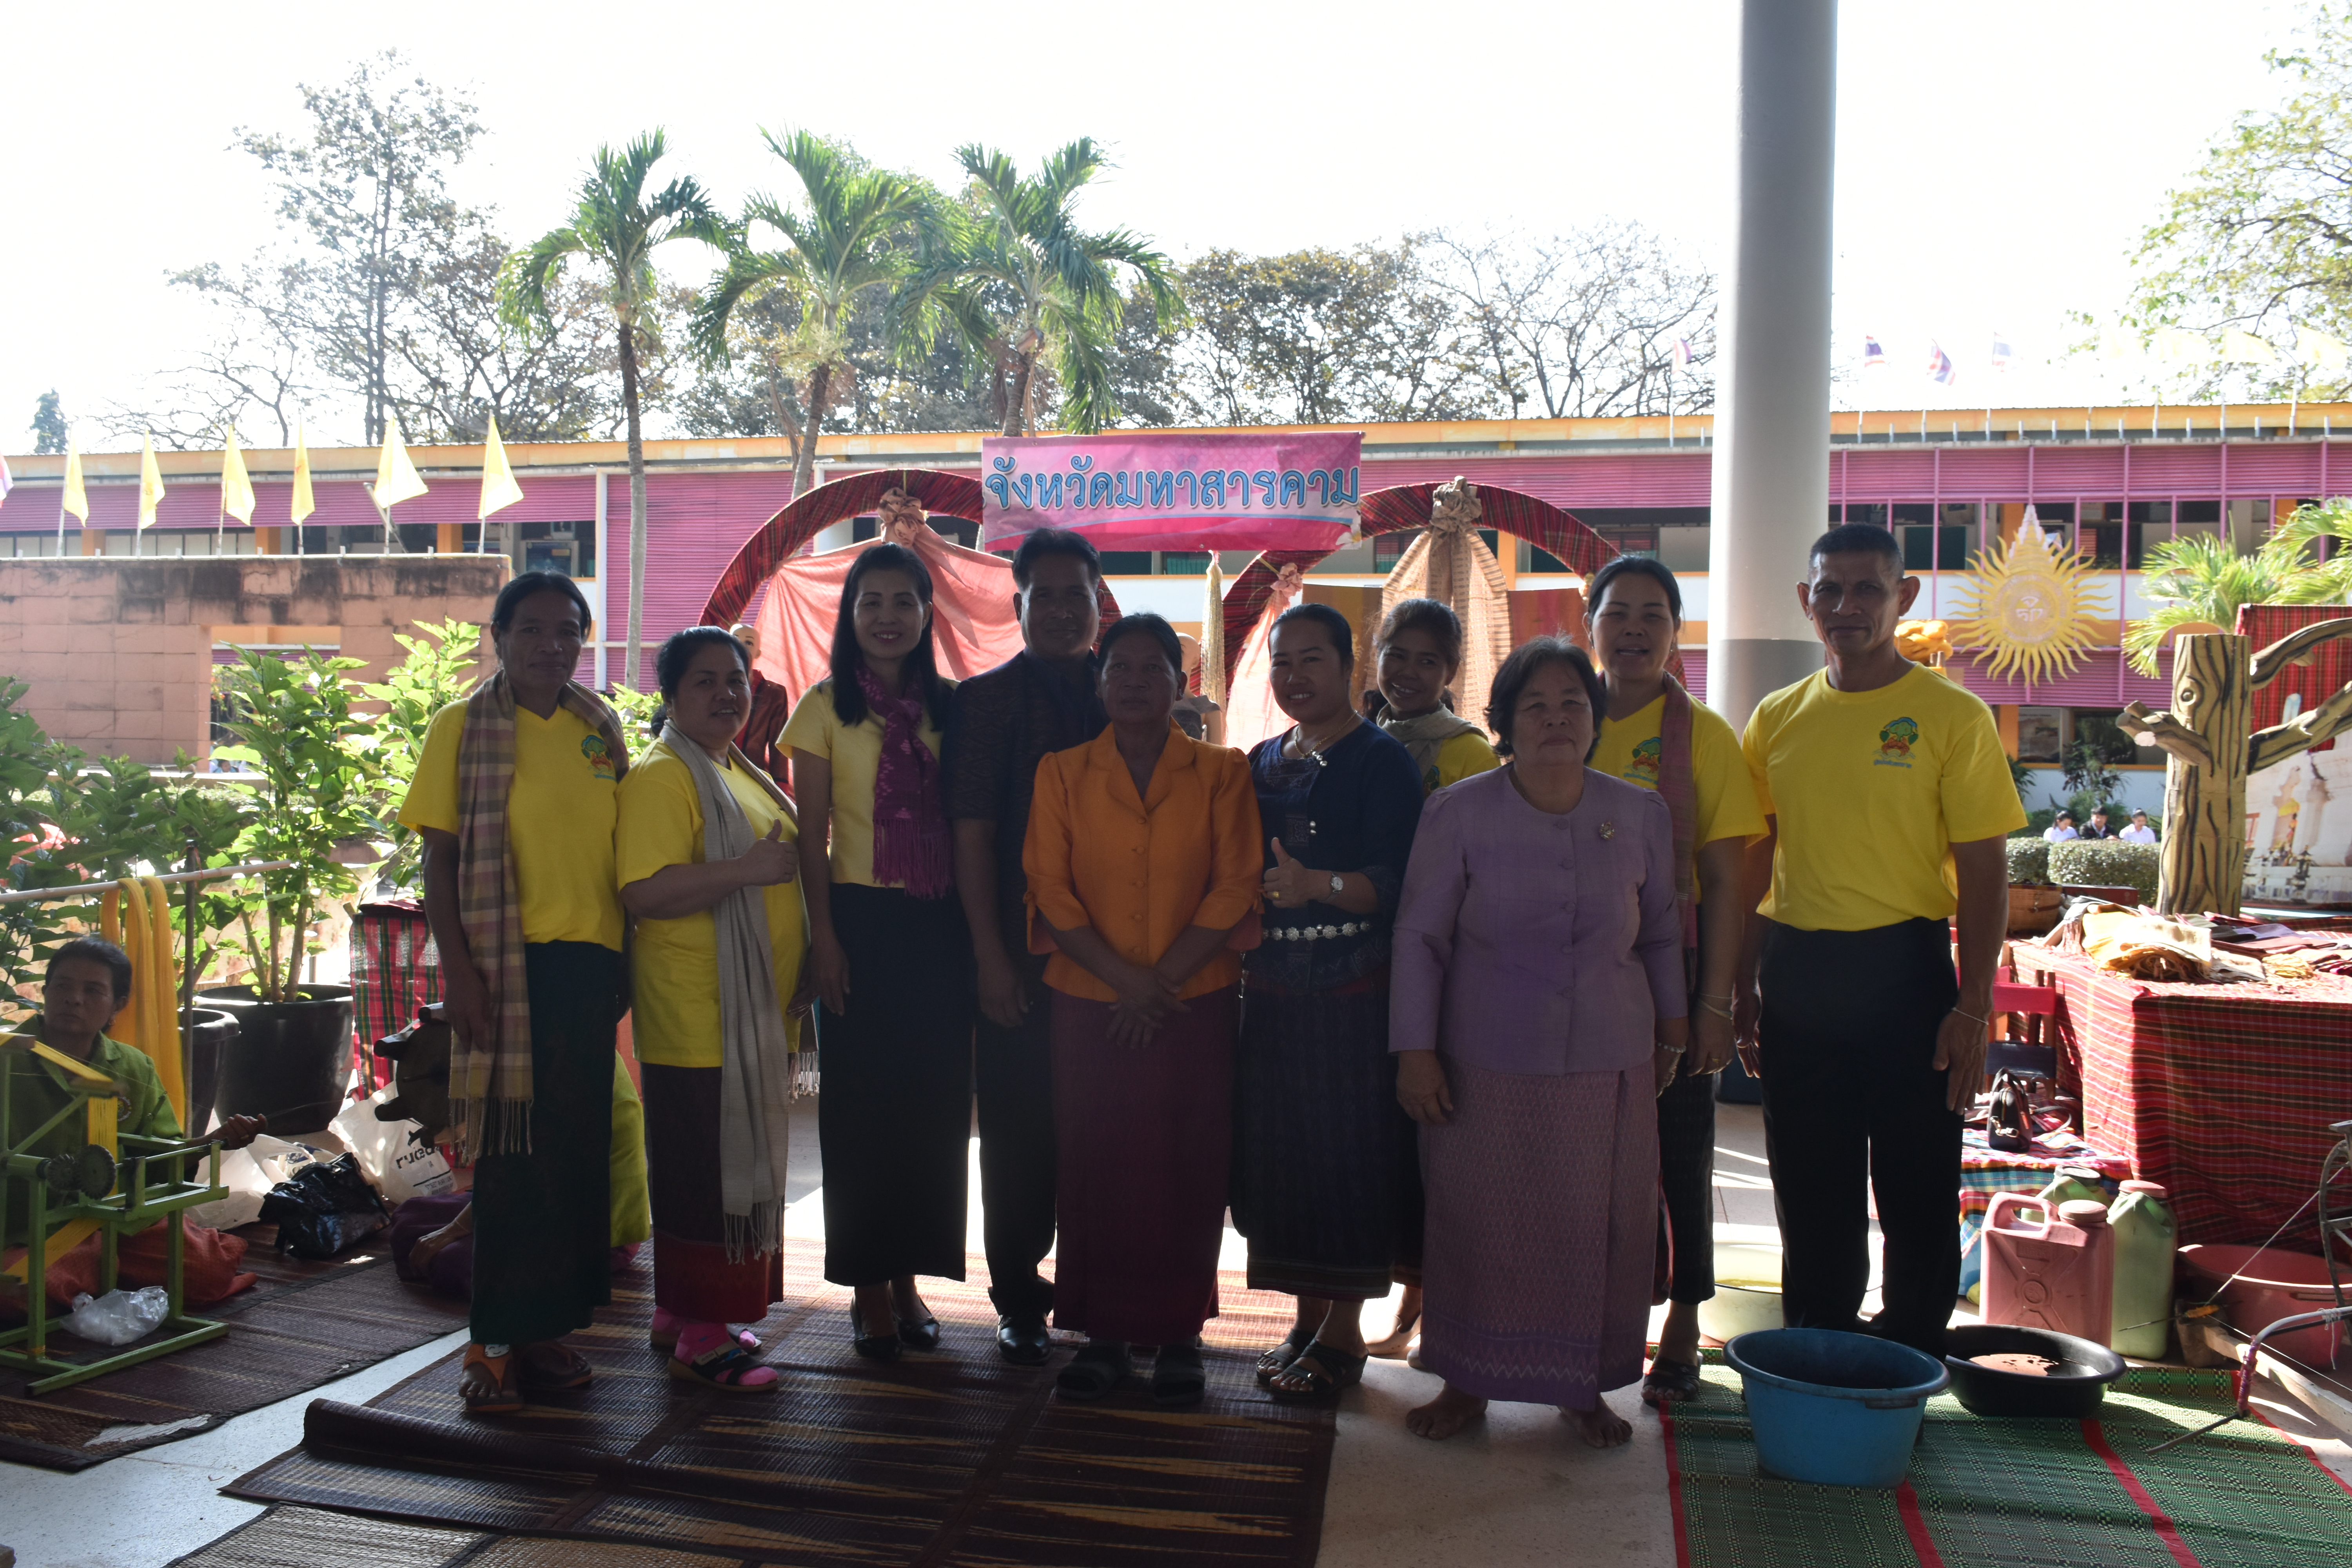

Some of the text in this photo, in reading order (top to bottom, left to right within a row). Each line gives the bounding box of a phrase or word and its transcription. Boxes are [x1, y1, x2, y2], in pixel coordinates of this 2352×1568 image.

[985, 456, 1359, 509] จังหวัดมหาสารคาม
